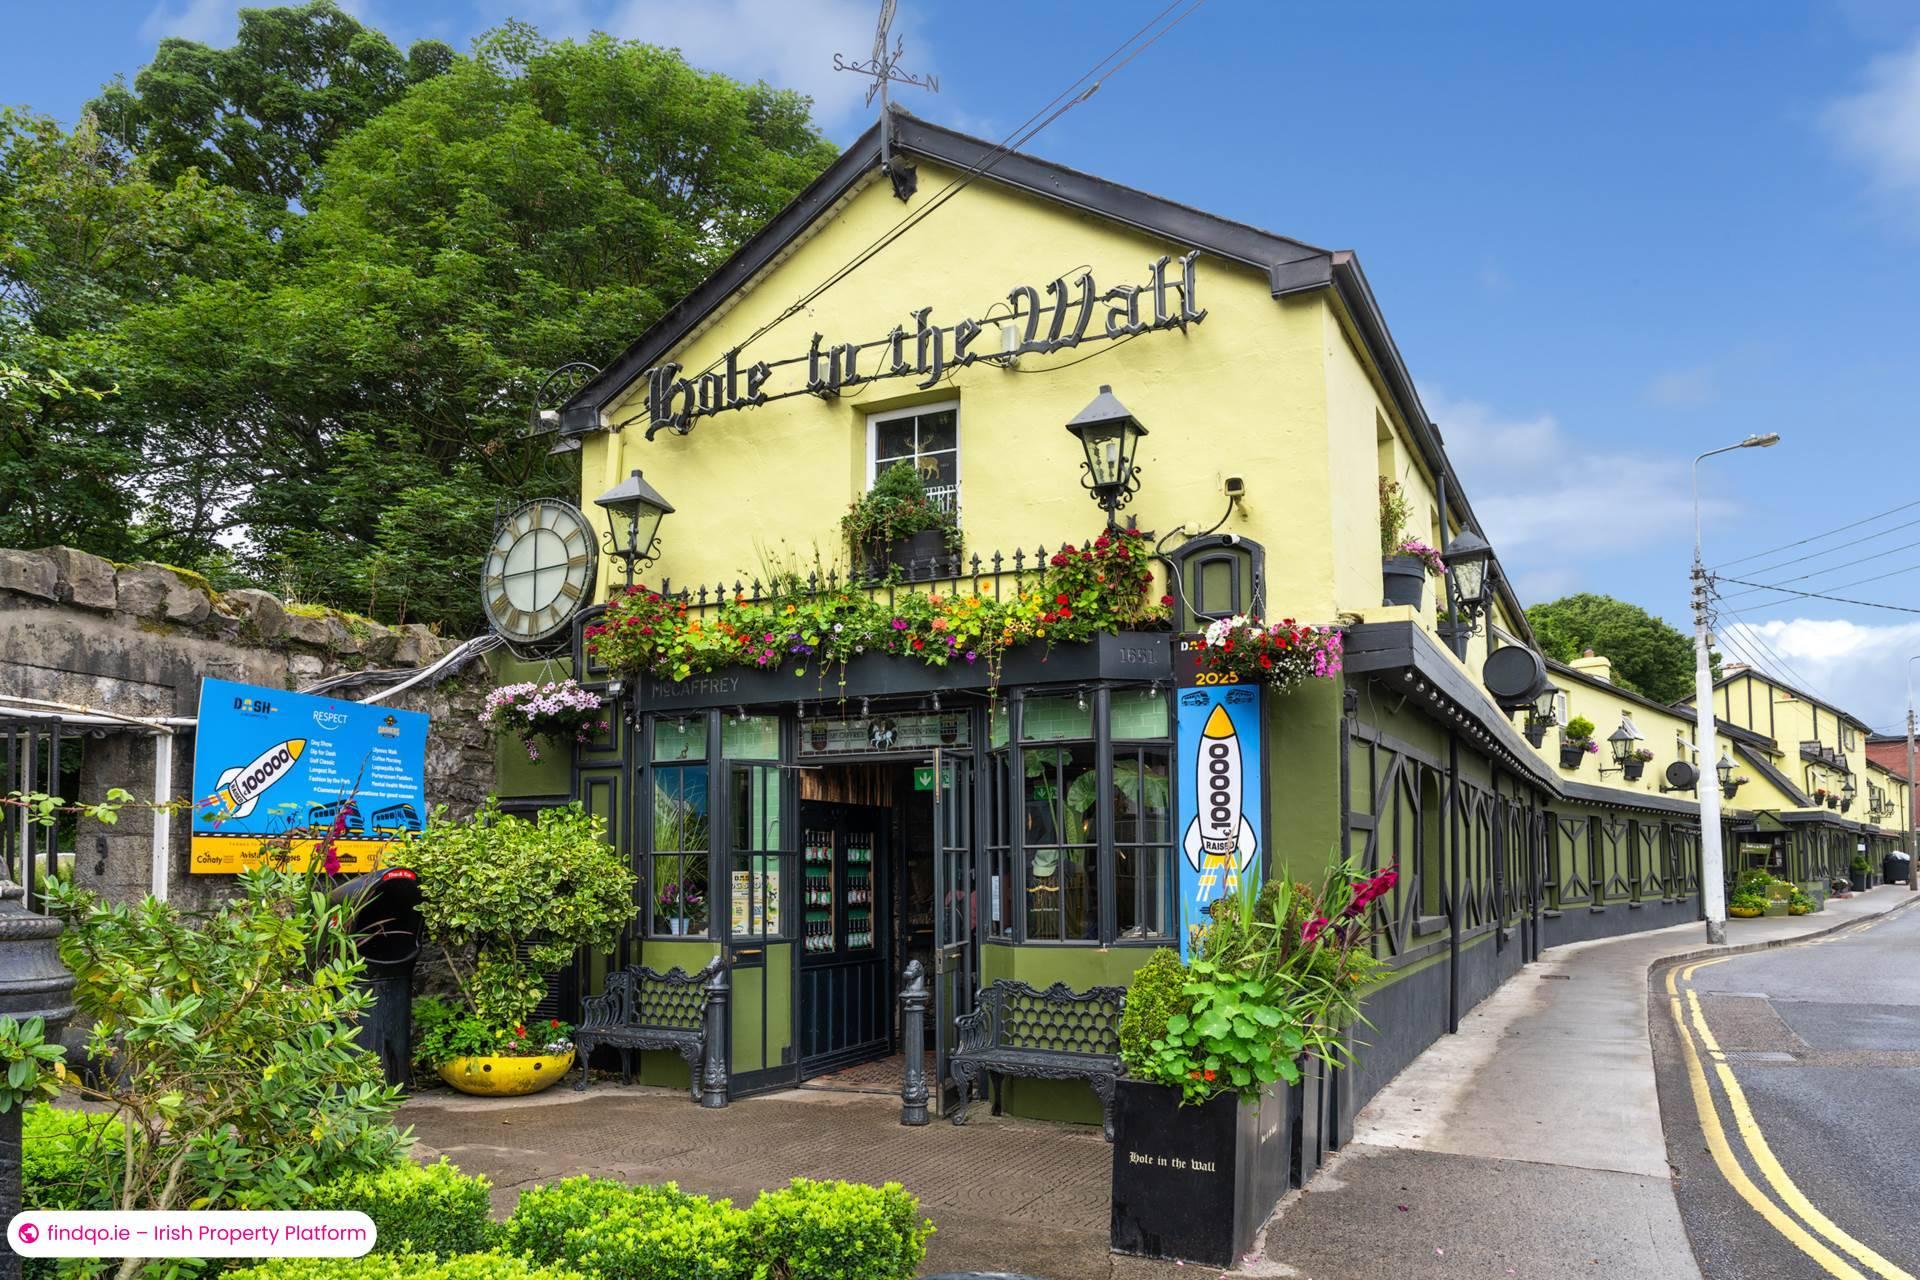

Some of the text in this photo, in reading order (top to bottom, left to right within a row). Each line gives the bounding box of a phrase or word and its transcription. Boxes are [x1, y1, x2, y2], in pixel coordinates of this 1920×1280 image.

[644, 250, 1208, 441] Hole in the Wall
[1195, 671, 1239, 686] 2025
[313, 711, 348, 724] RESPECT
[1129, 1151, 1216, 1172] Hole in the Wall
